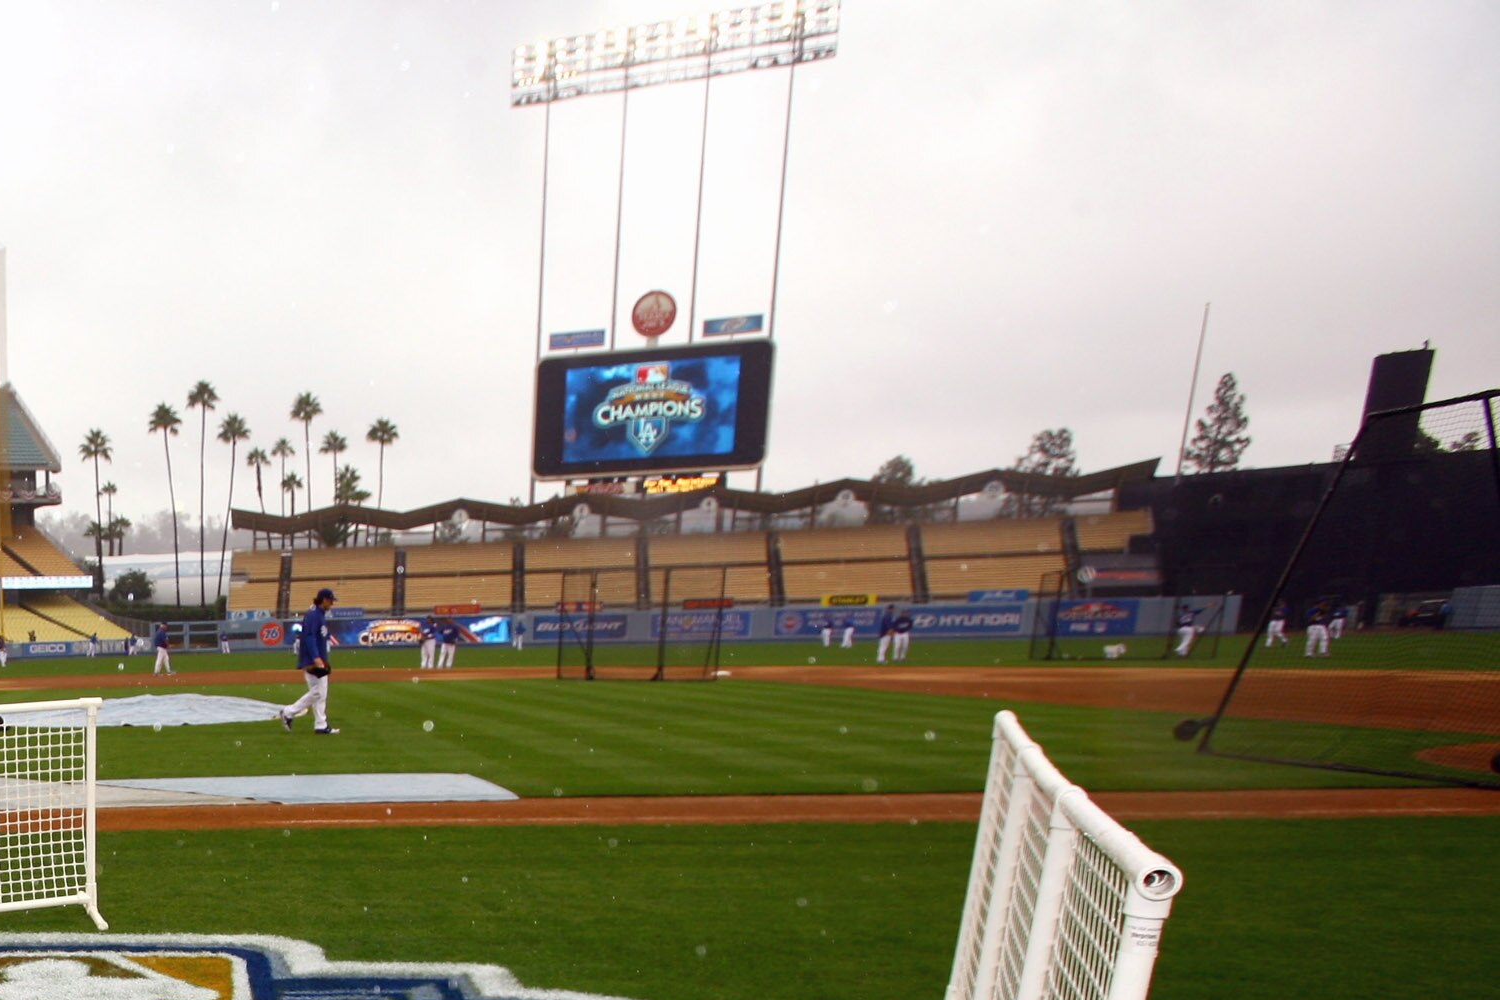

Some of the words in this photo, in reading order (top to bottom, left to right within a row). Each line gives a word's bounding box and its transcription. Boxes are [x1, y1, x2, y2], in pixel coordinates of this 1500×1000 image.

[597, 399, 702, 425] CHAMPIONS
[939, 613, 1020, 626] HYUNDAI
[264, 628, 280, 639] 76
[359, 631, 422, 647] CHAMPION
[29, 642, 66, 653] GEICO
